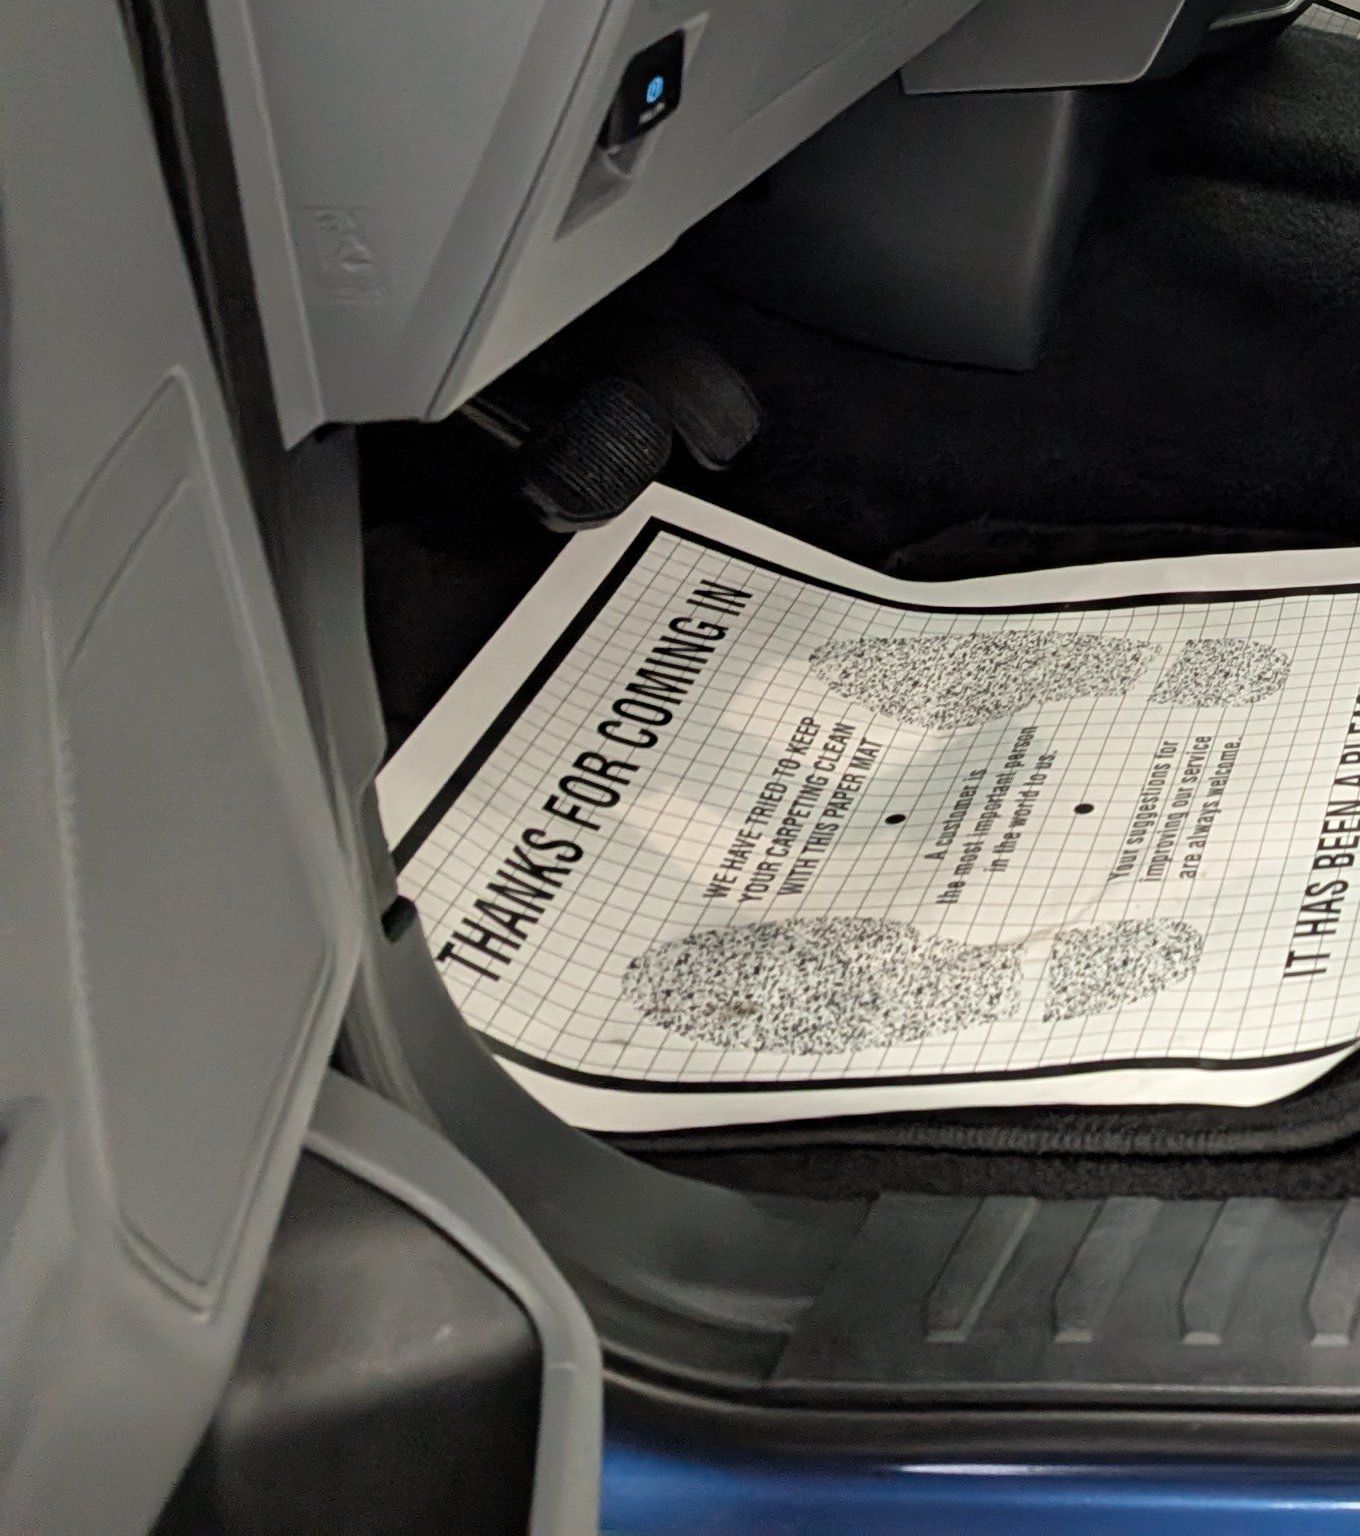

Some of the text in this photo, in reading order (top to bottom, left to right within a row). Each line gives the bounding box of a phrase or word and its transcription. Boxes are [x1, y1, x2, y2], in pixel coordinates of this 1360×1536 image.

[436, 579, 753, 982] THANKS FOR COMING IN
[702, 717, 821, 898] WE HAVE TRIED TO KEEP
[738, 722, 856, 903] YOUR CARPETING CLEAN
[777, 737, 883, 895] WITH THIS PAPER MAT
[924, 768, 987, 860] A customer is
[936, 726, 1037, 904] the most important person
[983, 750, 1058, 872] in the world to us.
[1107, 741, 1179, 881] Your suggestions for
[1139, 736, 1212, 882] improving our service
[1180, 737, 1242, 879] are always welcome.
[1283, 951, 1331, 978] IT
[1293, 879, 1349, 939] HAS
